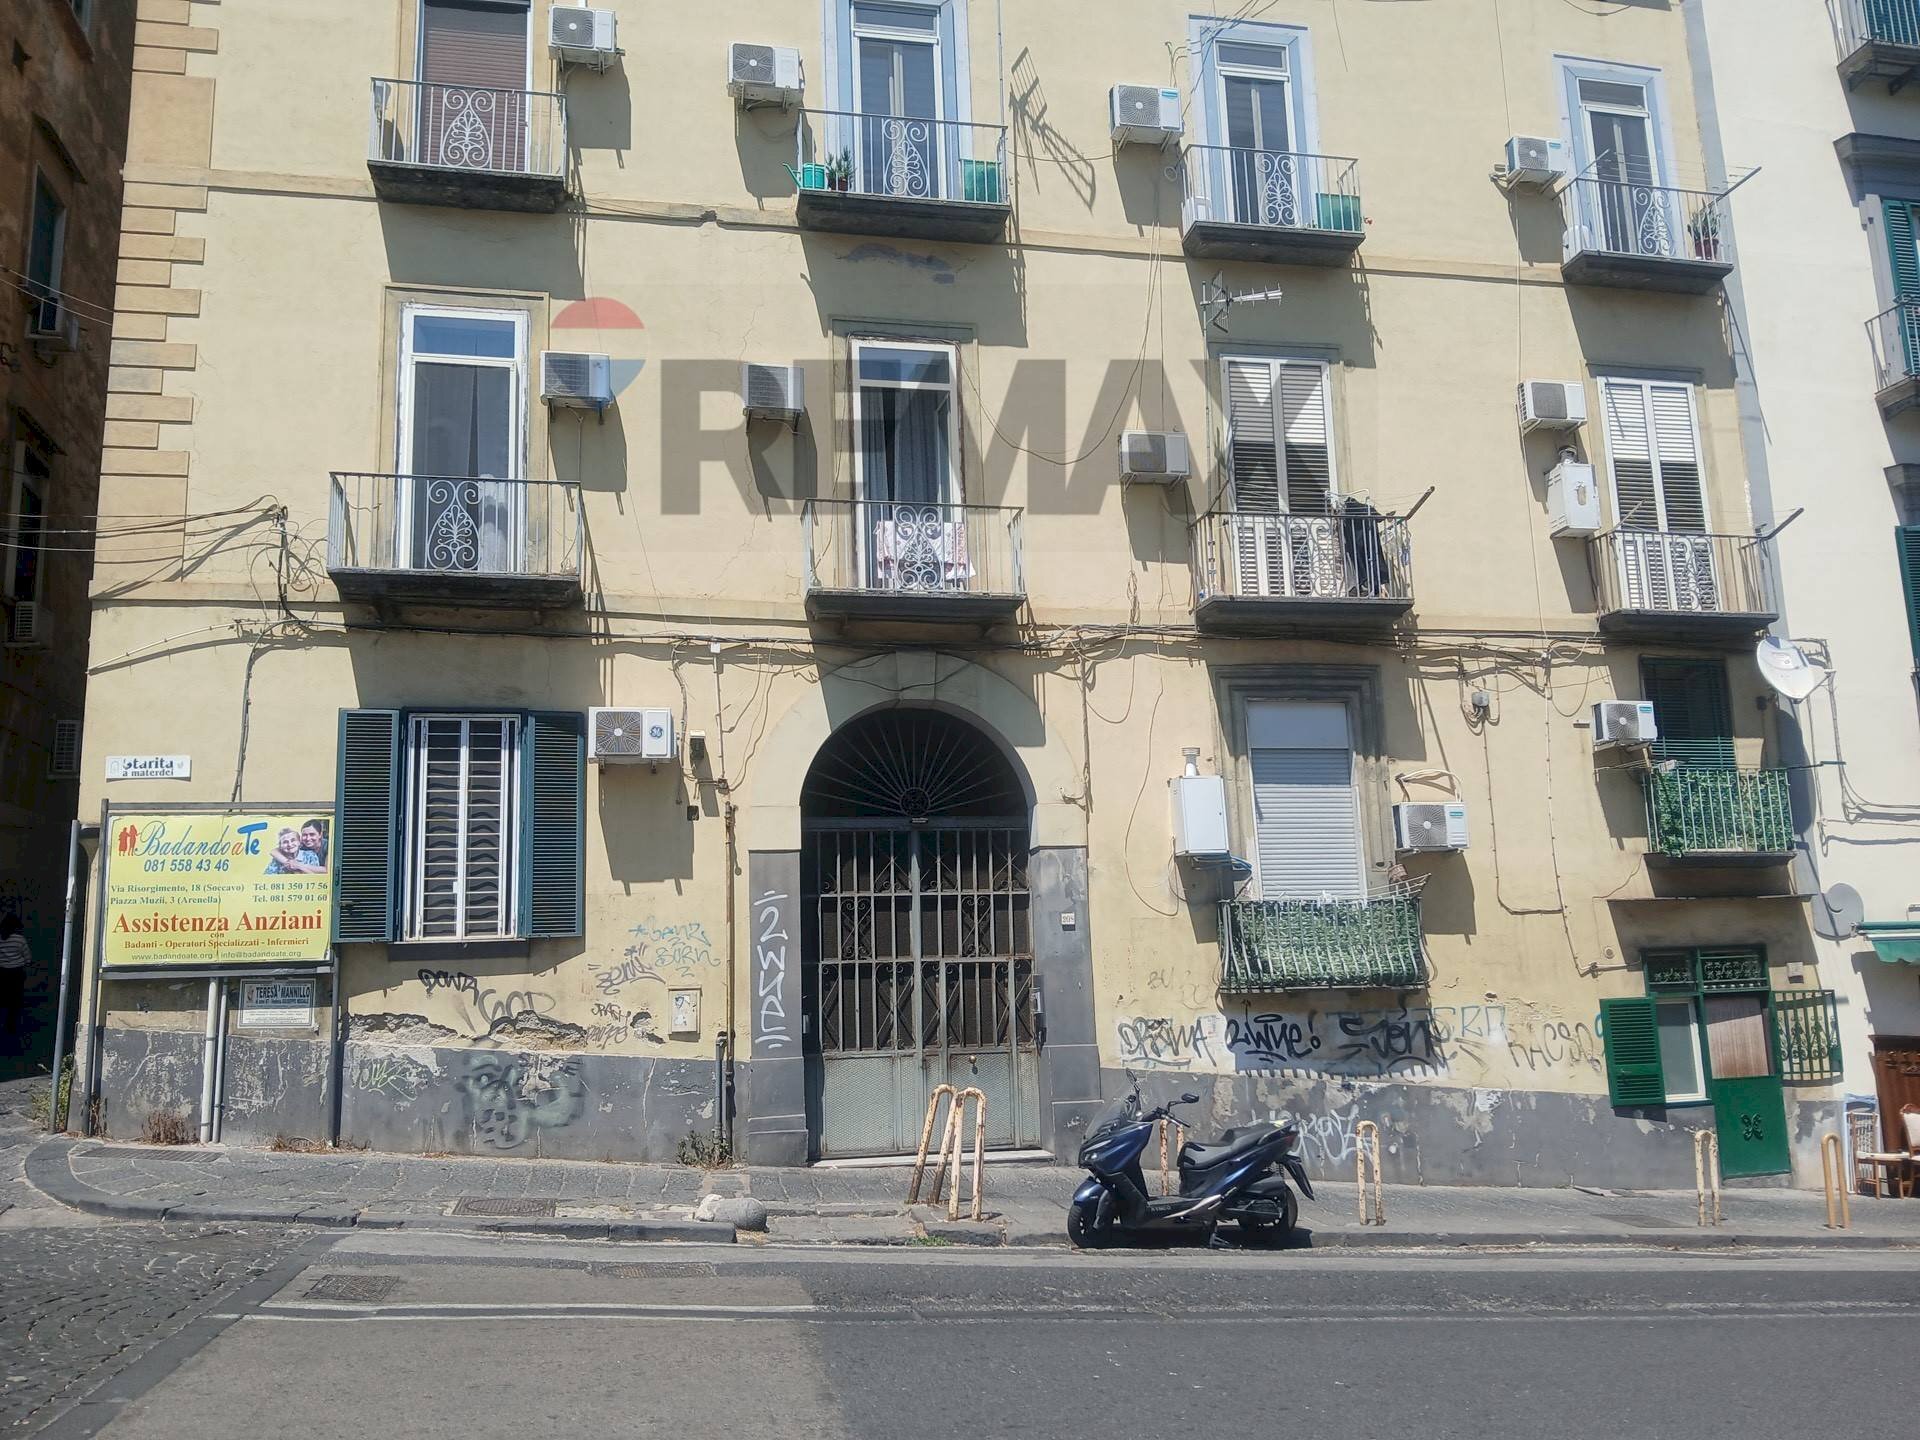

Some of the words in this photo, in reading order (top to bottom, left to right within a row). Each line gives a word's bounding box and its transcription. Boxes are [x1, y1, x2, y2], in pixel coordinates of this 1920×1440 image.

[144, 859, 165, 872] 081
[170, 859, 192, 872] 558
[195, 859, 211, 872] 43
[214, 859, 230, 871] 46
[288, 882, 303, 890] 350
[306, 882, 315, 890] 17
[318, 882, 328, 890] 56
[288, 894, 303, 902] 579
[112, 912, 229, 933] Assistenza
[235, 909, 322, 931] Anziani
[124, 940, 157, 948] Badanti
[165, 940, 206, 949] Operatori
[208, 938, 259, 949] Specializzati
[267, 938, 308, 946] Infermieri
